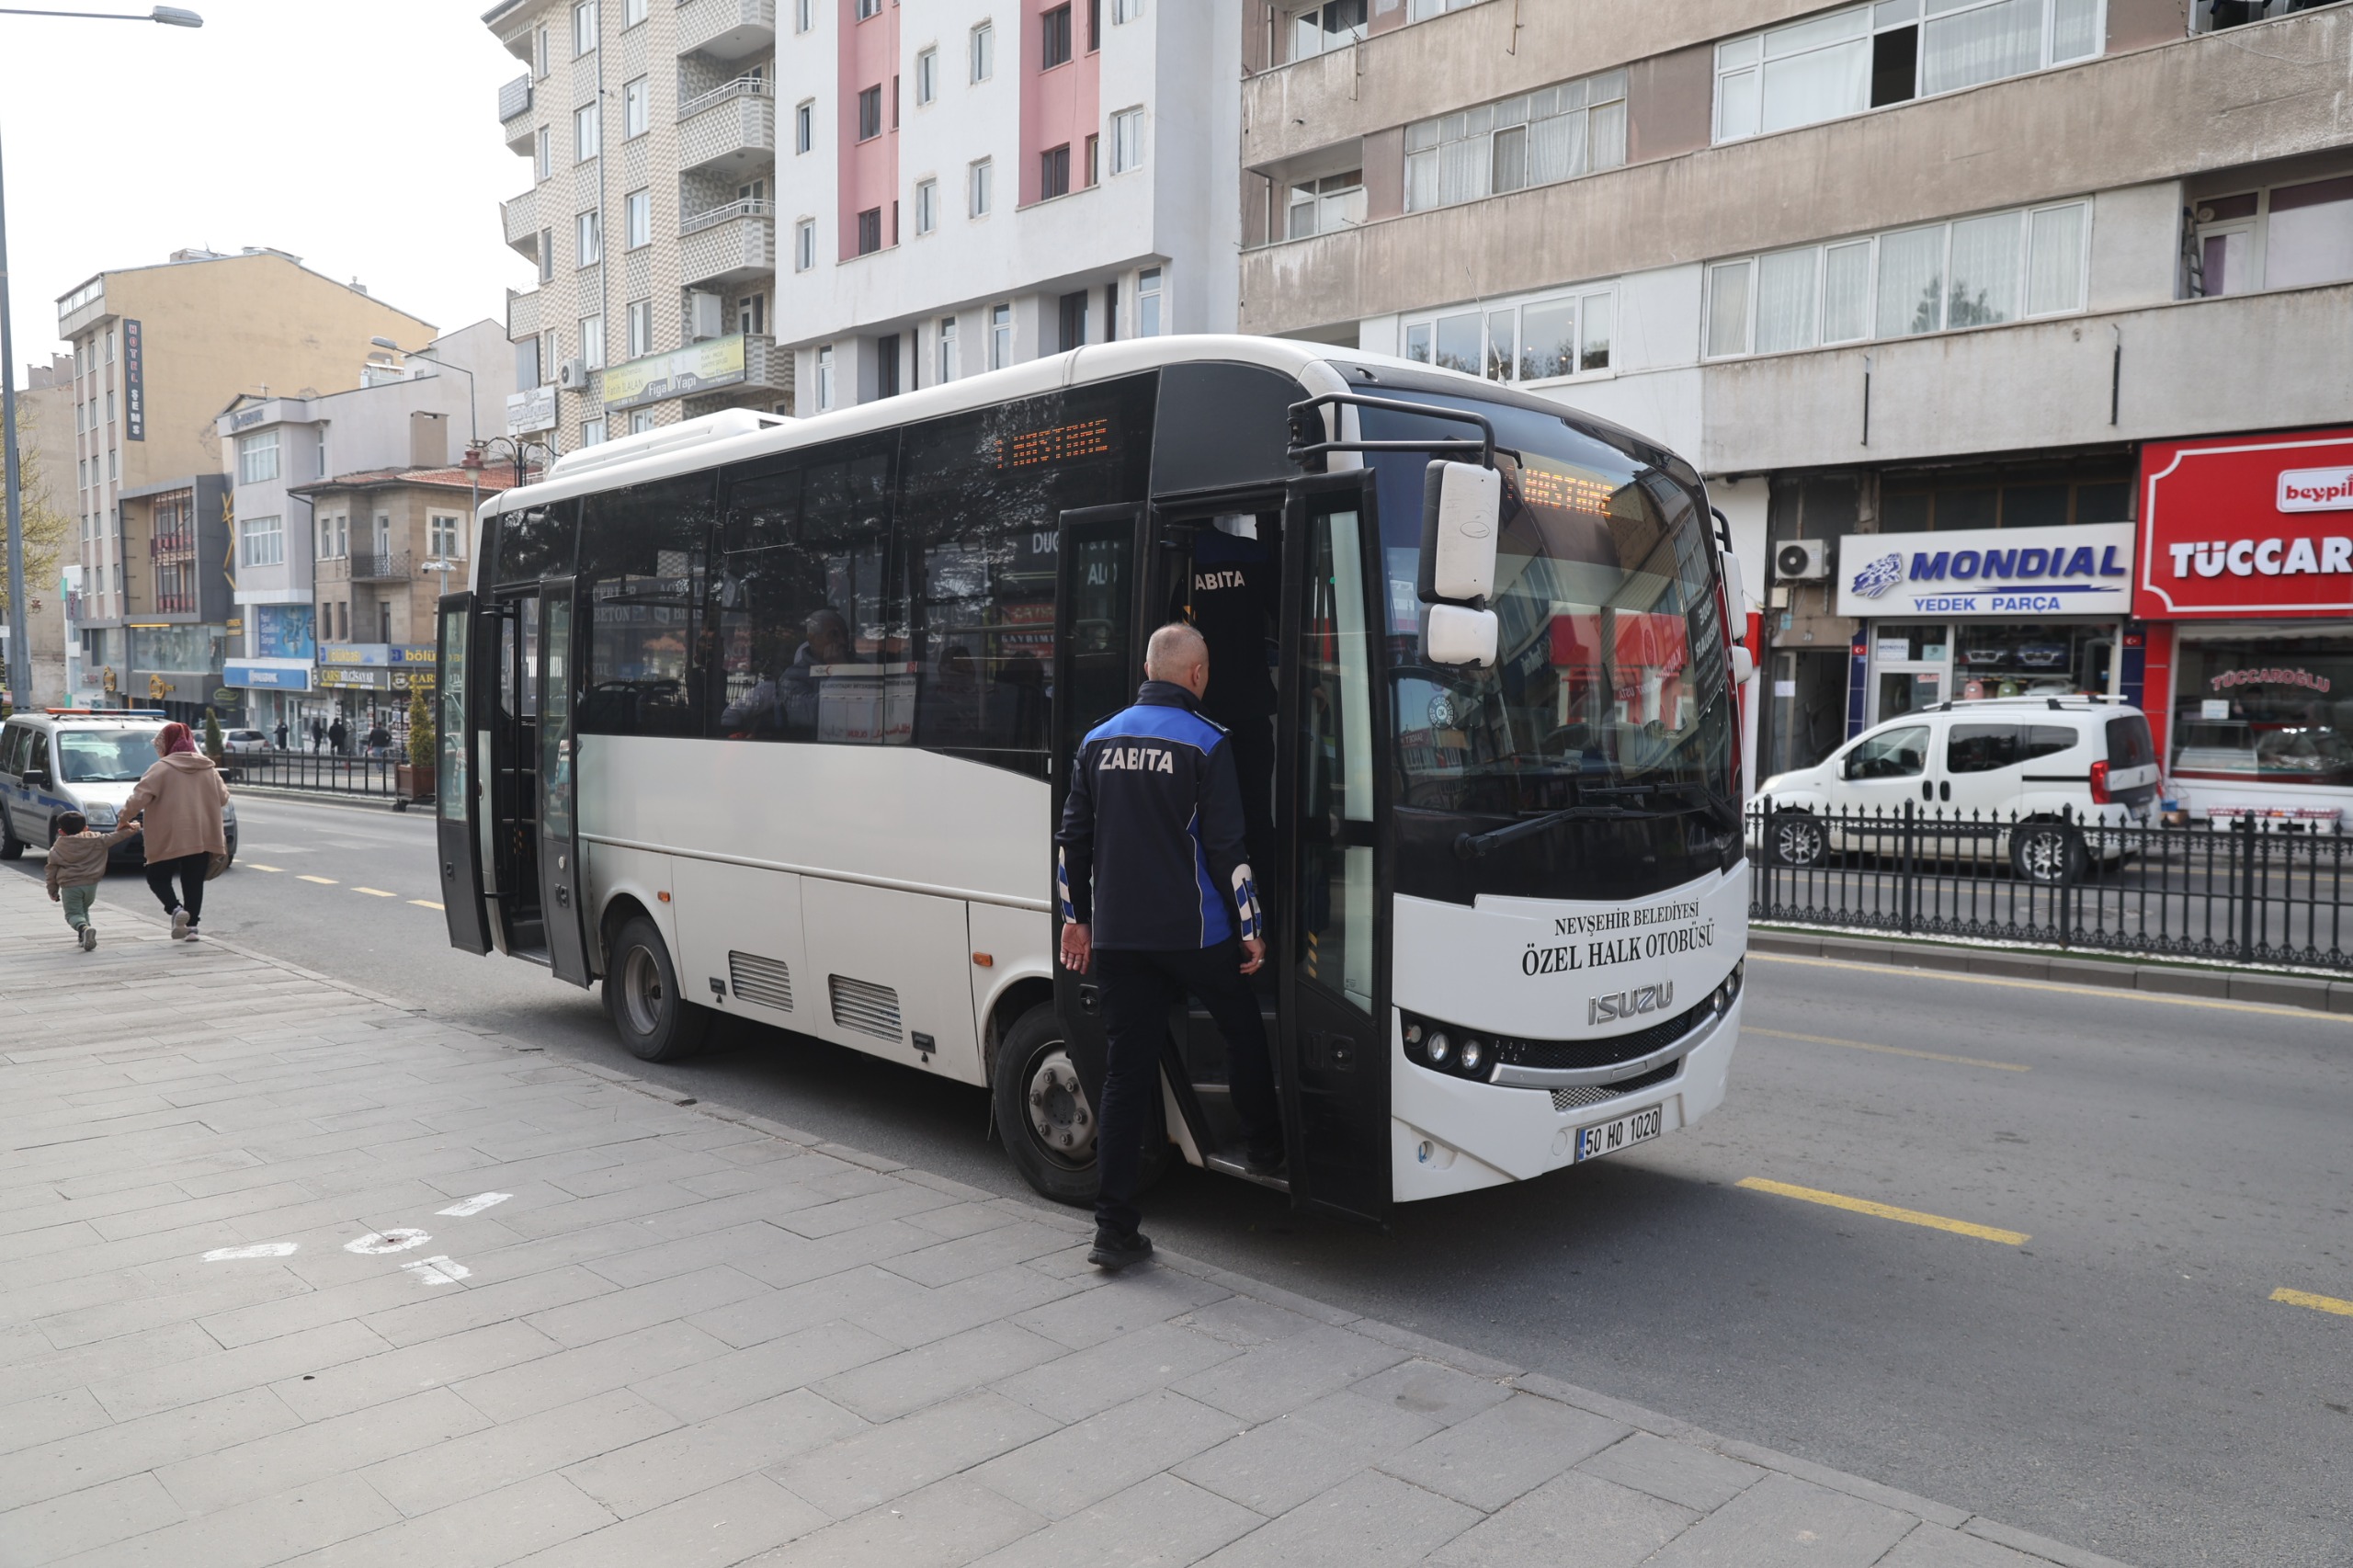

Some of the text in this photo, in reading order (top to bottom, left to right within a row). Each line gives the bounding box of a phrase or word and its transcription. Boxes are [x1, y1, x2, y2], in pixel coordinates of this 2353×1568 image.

[129, 324, 138, 383] HOTEL
[648, 375, 697, 397] Figa Yapı
[1909, 546, 2127, 581] MONDIAL
[1195, 570, 1245, 591] ABITA
[594, 607, 630, 622] BETON
[1914, 596, 2061, 613] YEDEK PARÇA
[2211, 667, 2331, 693] TÜCCAROĞLU
[1098, 746, 1174, 774] ZABITA
[1554, 897, 1699, 937] NEVŞEHİR BELEDİYESİ
[1521, 917, 1715, 976] ÖZEL HALK OTOBÜSÜ
[1587, 979, 1674, 1026] ISUZU
[1586, 1128, 1602, 1156] 50
[1607, 1121, 1624, 1149] HO
[1631, 1110, 1659, 1142] 1020
